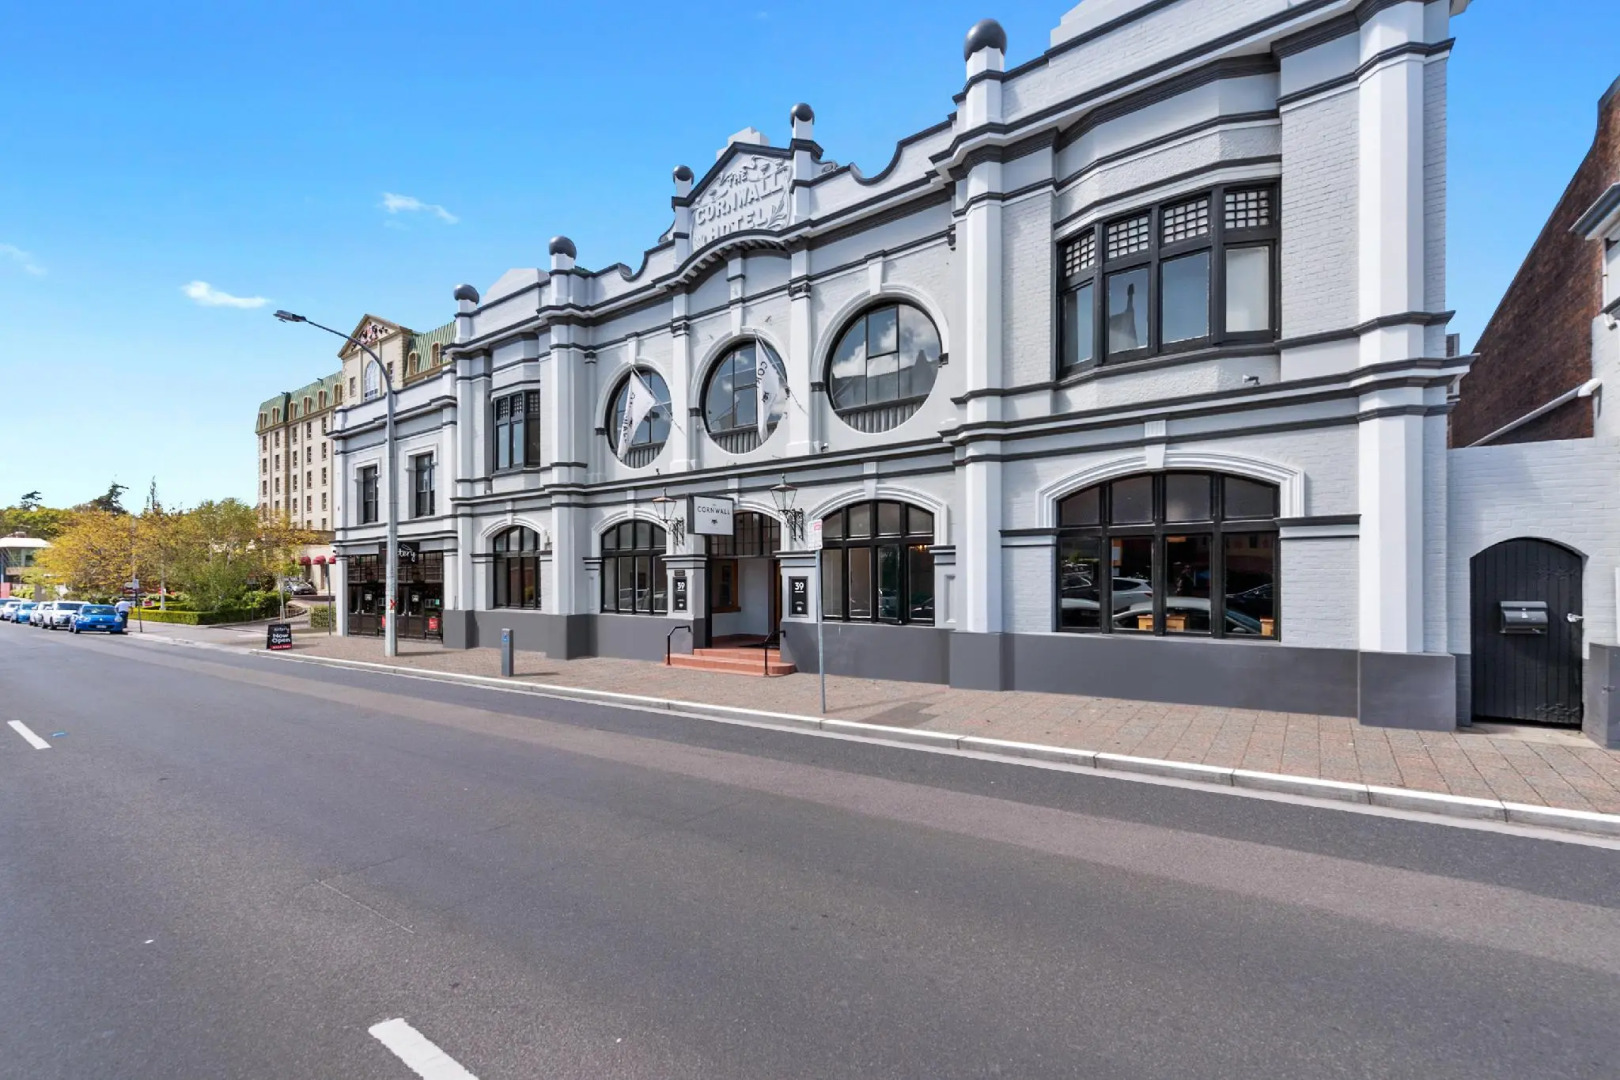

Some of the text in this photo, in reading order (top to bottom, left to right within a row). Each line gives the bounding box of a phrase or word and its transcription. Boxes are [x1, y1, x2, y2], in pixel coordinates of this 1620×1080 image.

[728, 169, 749, 189] THE
[695, 169, 785, 226] CORNWALL
[710, 207, 769, 240] HOTEL
[697, 505, 731, 515] CORNWALL
[677, 581, 686, 590] 39
[794, 581, 805, 591] 39
